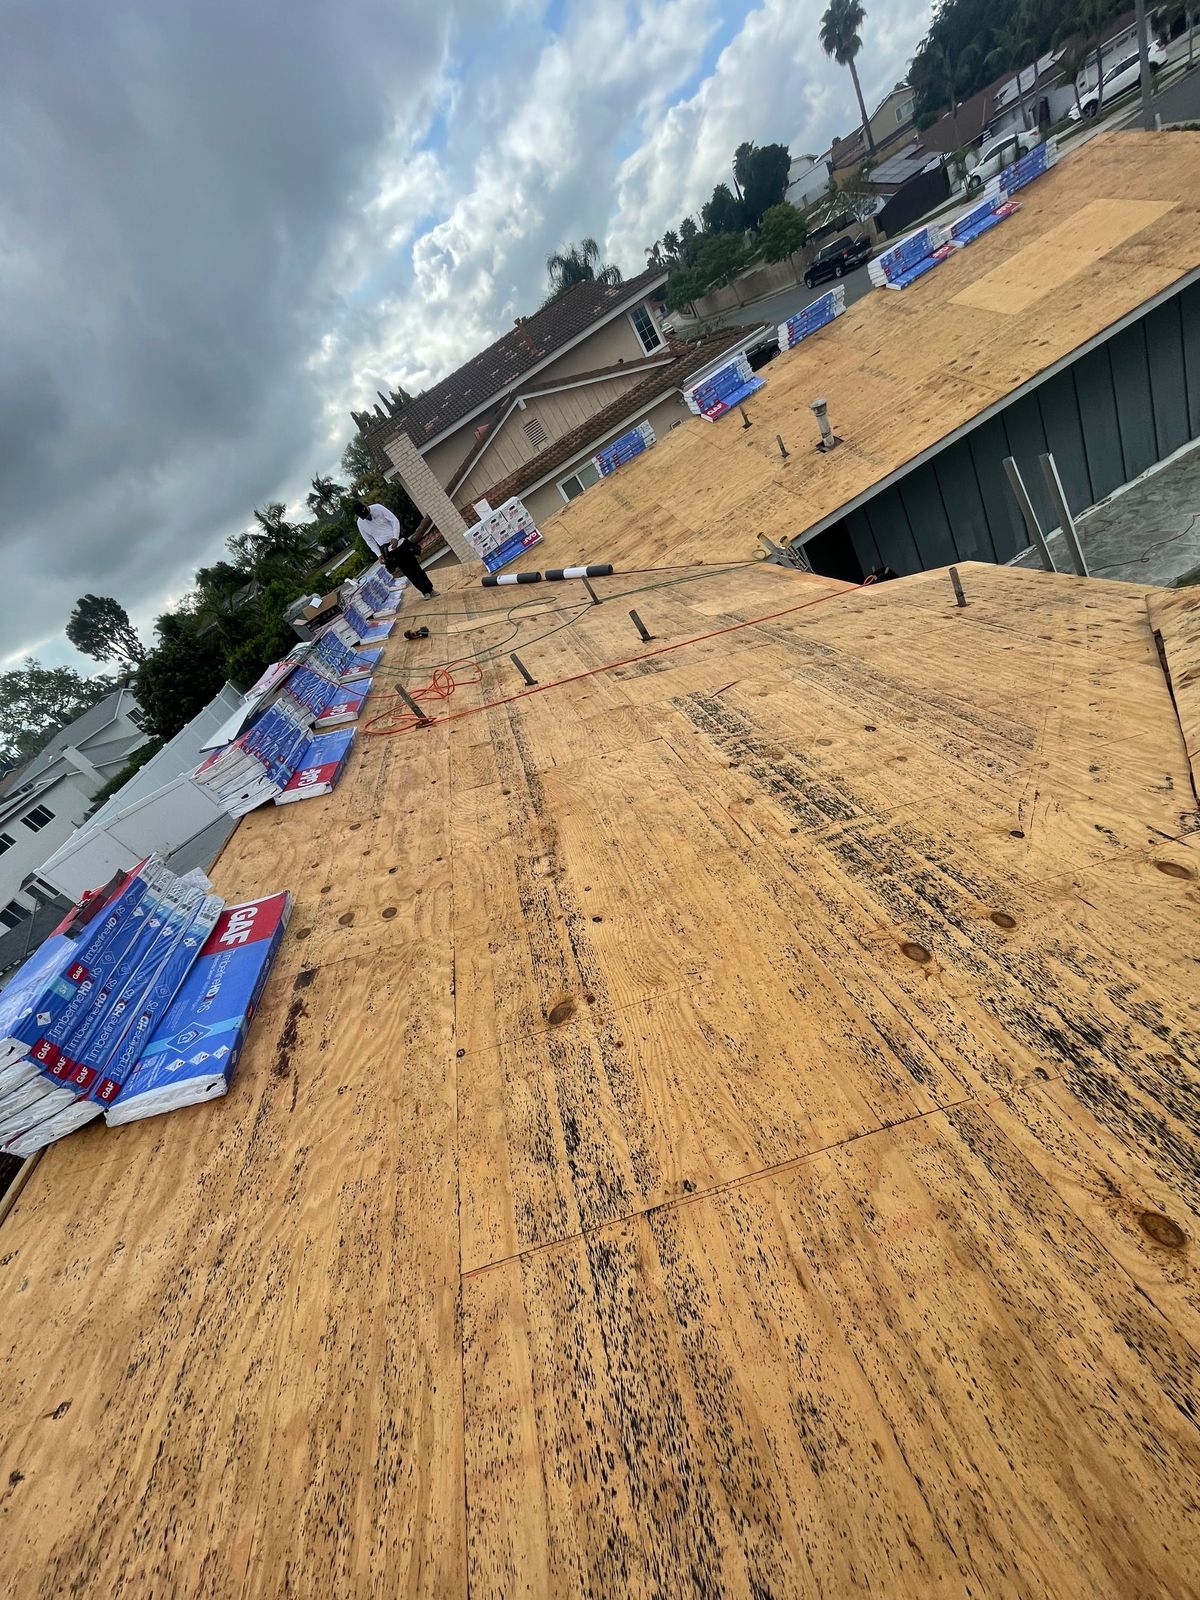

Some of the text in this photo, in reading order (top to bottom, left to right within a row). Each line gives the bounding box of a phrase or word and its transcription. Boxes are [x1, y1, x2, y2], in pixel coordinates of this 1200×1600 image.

[297, 768, 322, 786] GAF
[219, 907, 258, 946] GAF
[72, 966, 84, 980] GAF
[37, 1042, 52, 1060] GAF
[53, 1056, 67, 1074] GAF
[76, 1066, 89, 1083] GAF
[102, 1081, 114, 1098] GAF
